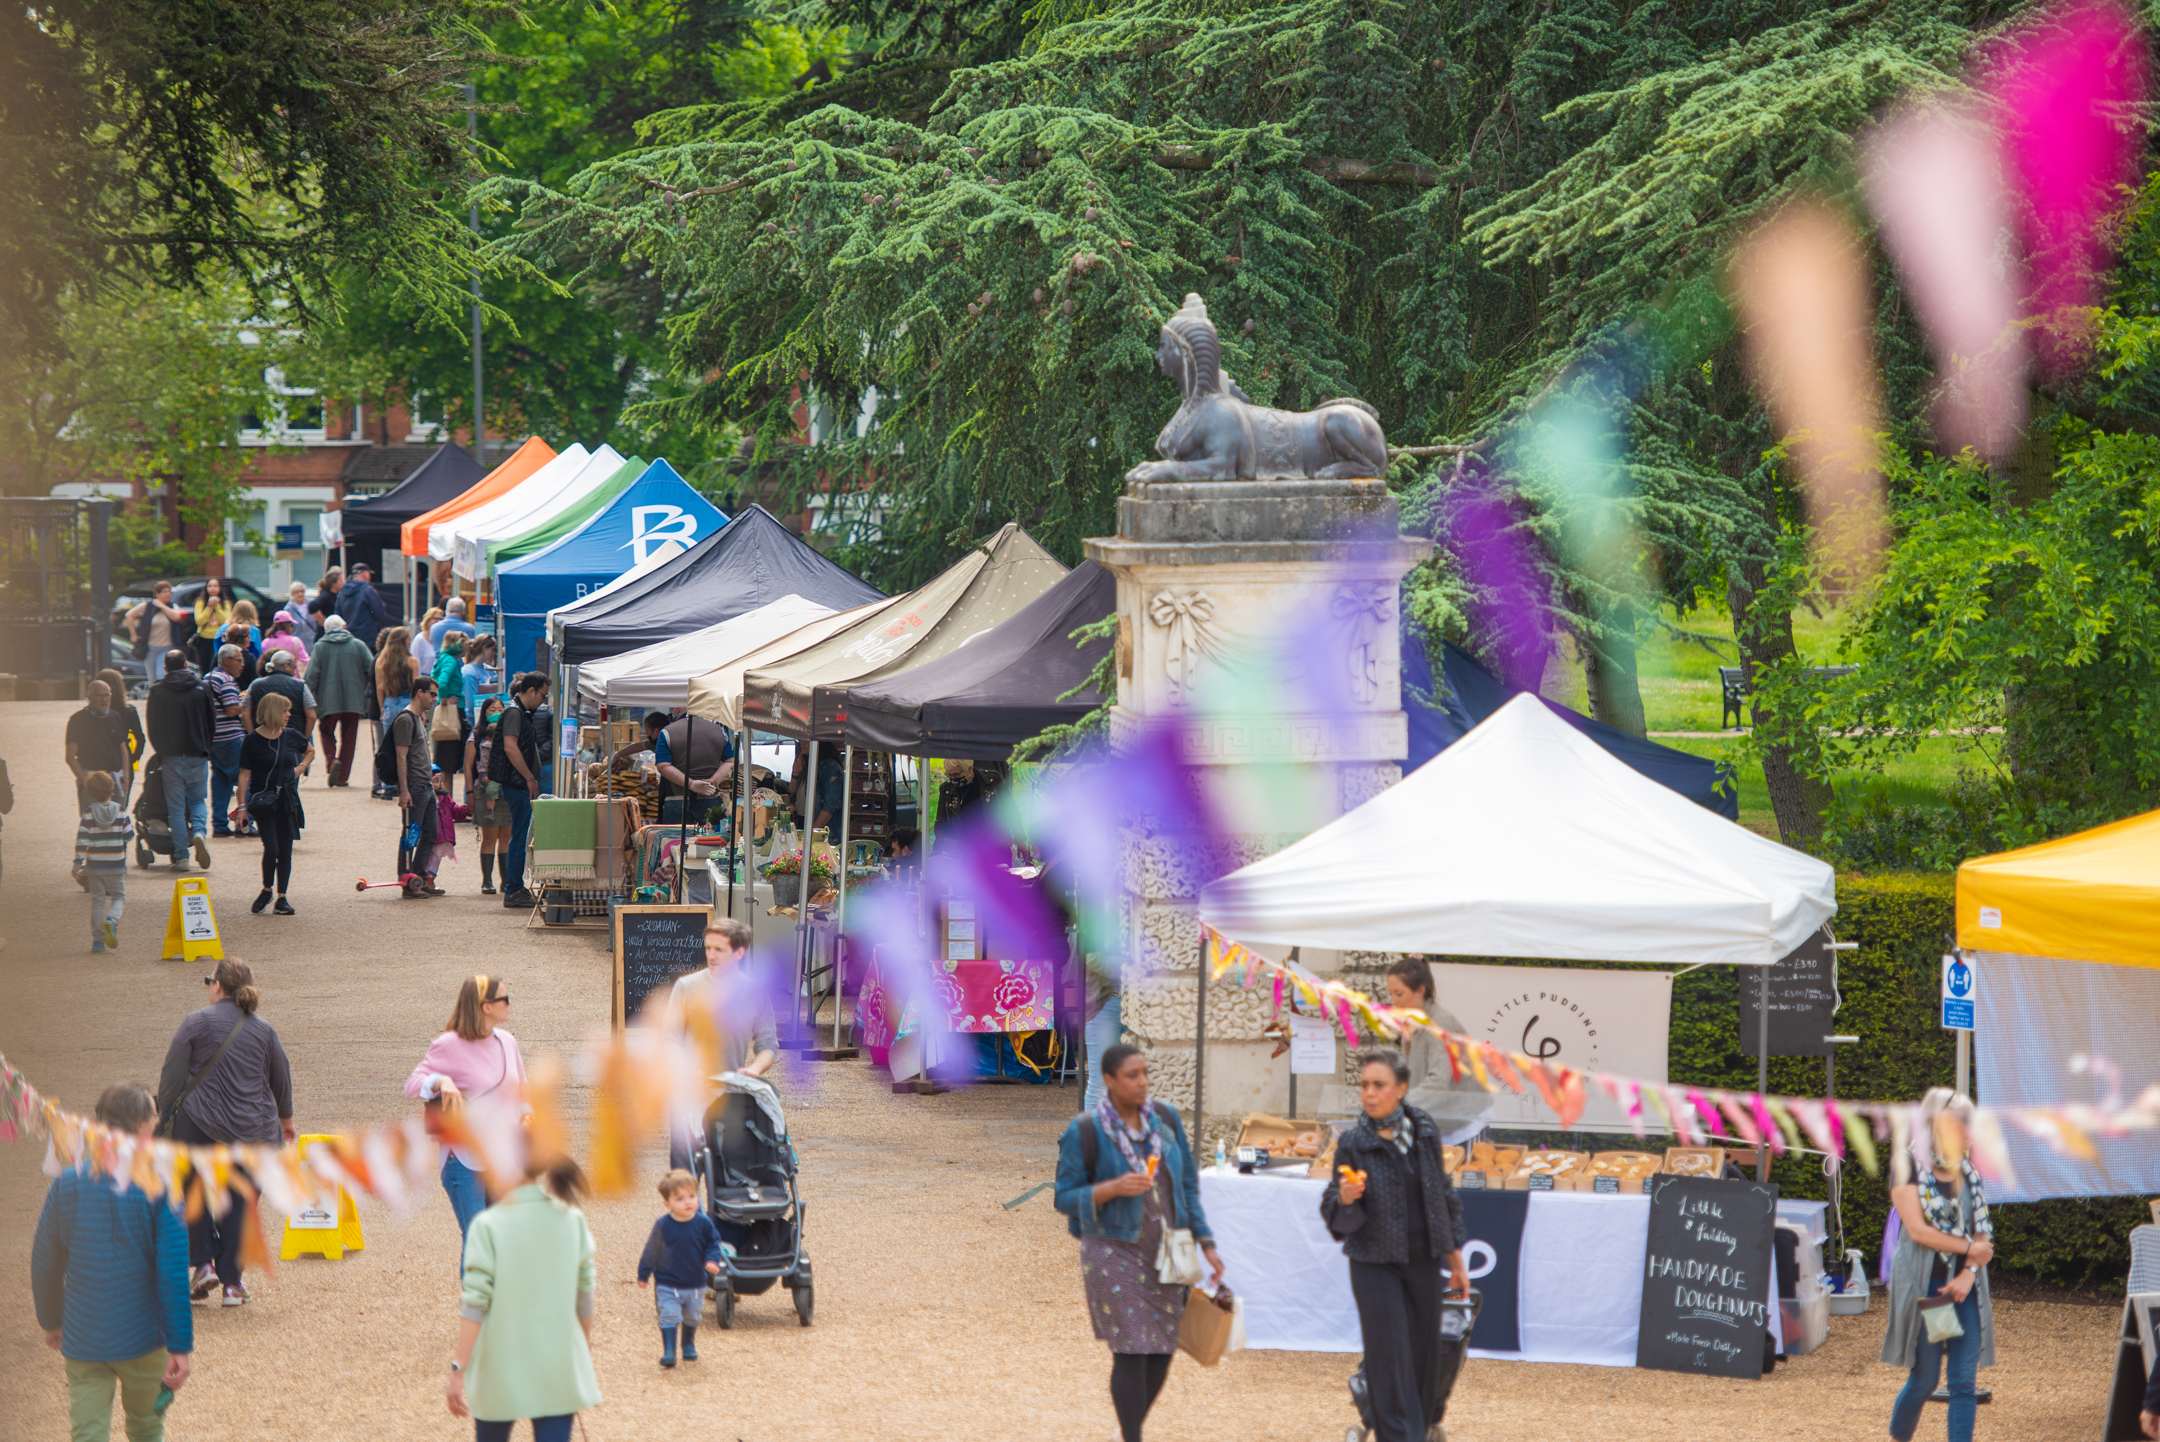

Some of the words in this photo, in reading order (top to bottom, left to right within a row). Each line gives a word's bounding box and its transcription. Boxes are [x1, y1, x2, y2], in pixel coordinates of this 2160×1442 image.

[633, 974, 670, 988] Truffles
[635, 961, 664, 973] Cheese
[1487, 994, 1530, 1032] LITTLE
[1540, 992, 1597, 1036] PUDDING
[1678, 1196, 1724, 1218] Little
[1697, 1223, 1737, 1256] Pudding
[1649, 1255, 1748, 1290] HANDMADE
[1675, 1286, 1766, 1326] DOUGHNUTS
[1671, 1332, 1690, 1344] Made
[1692, 1336, 1711, 1348] Fresh
[1714, 1340, 1737, 1362] Daily
